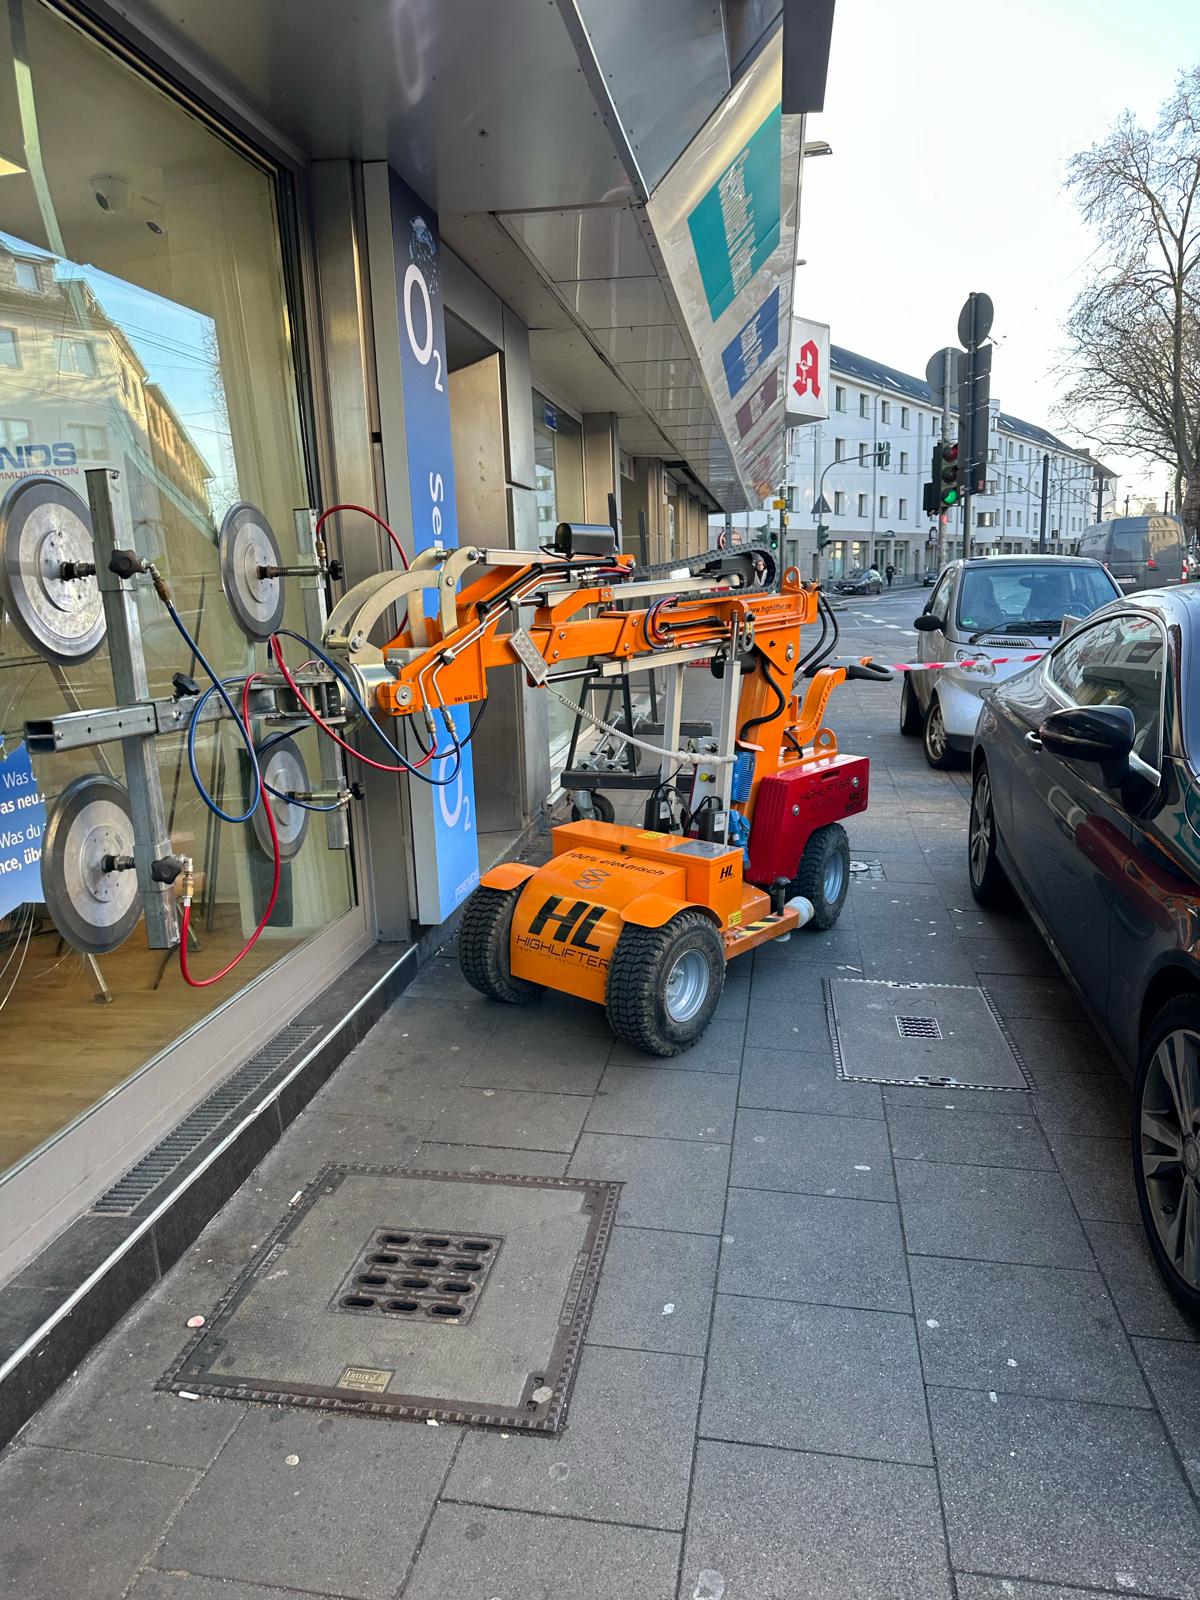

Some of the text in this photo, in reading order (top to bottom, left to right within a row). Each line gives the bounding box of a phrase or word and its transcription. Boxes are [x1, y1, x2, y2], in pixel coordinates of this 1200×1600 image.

[718, 148, 757, 296] Gesundheit & Wellness
[2, 771, 29, 789] Was
[0, 823, 41, 849] Was du
[600, 858, 665, 876] elektrisch
[720, 864, 734, 880] HL
[528, 895, 608, 952] HL
[515, 935, 611, 971] HIGHLIFTER
